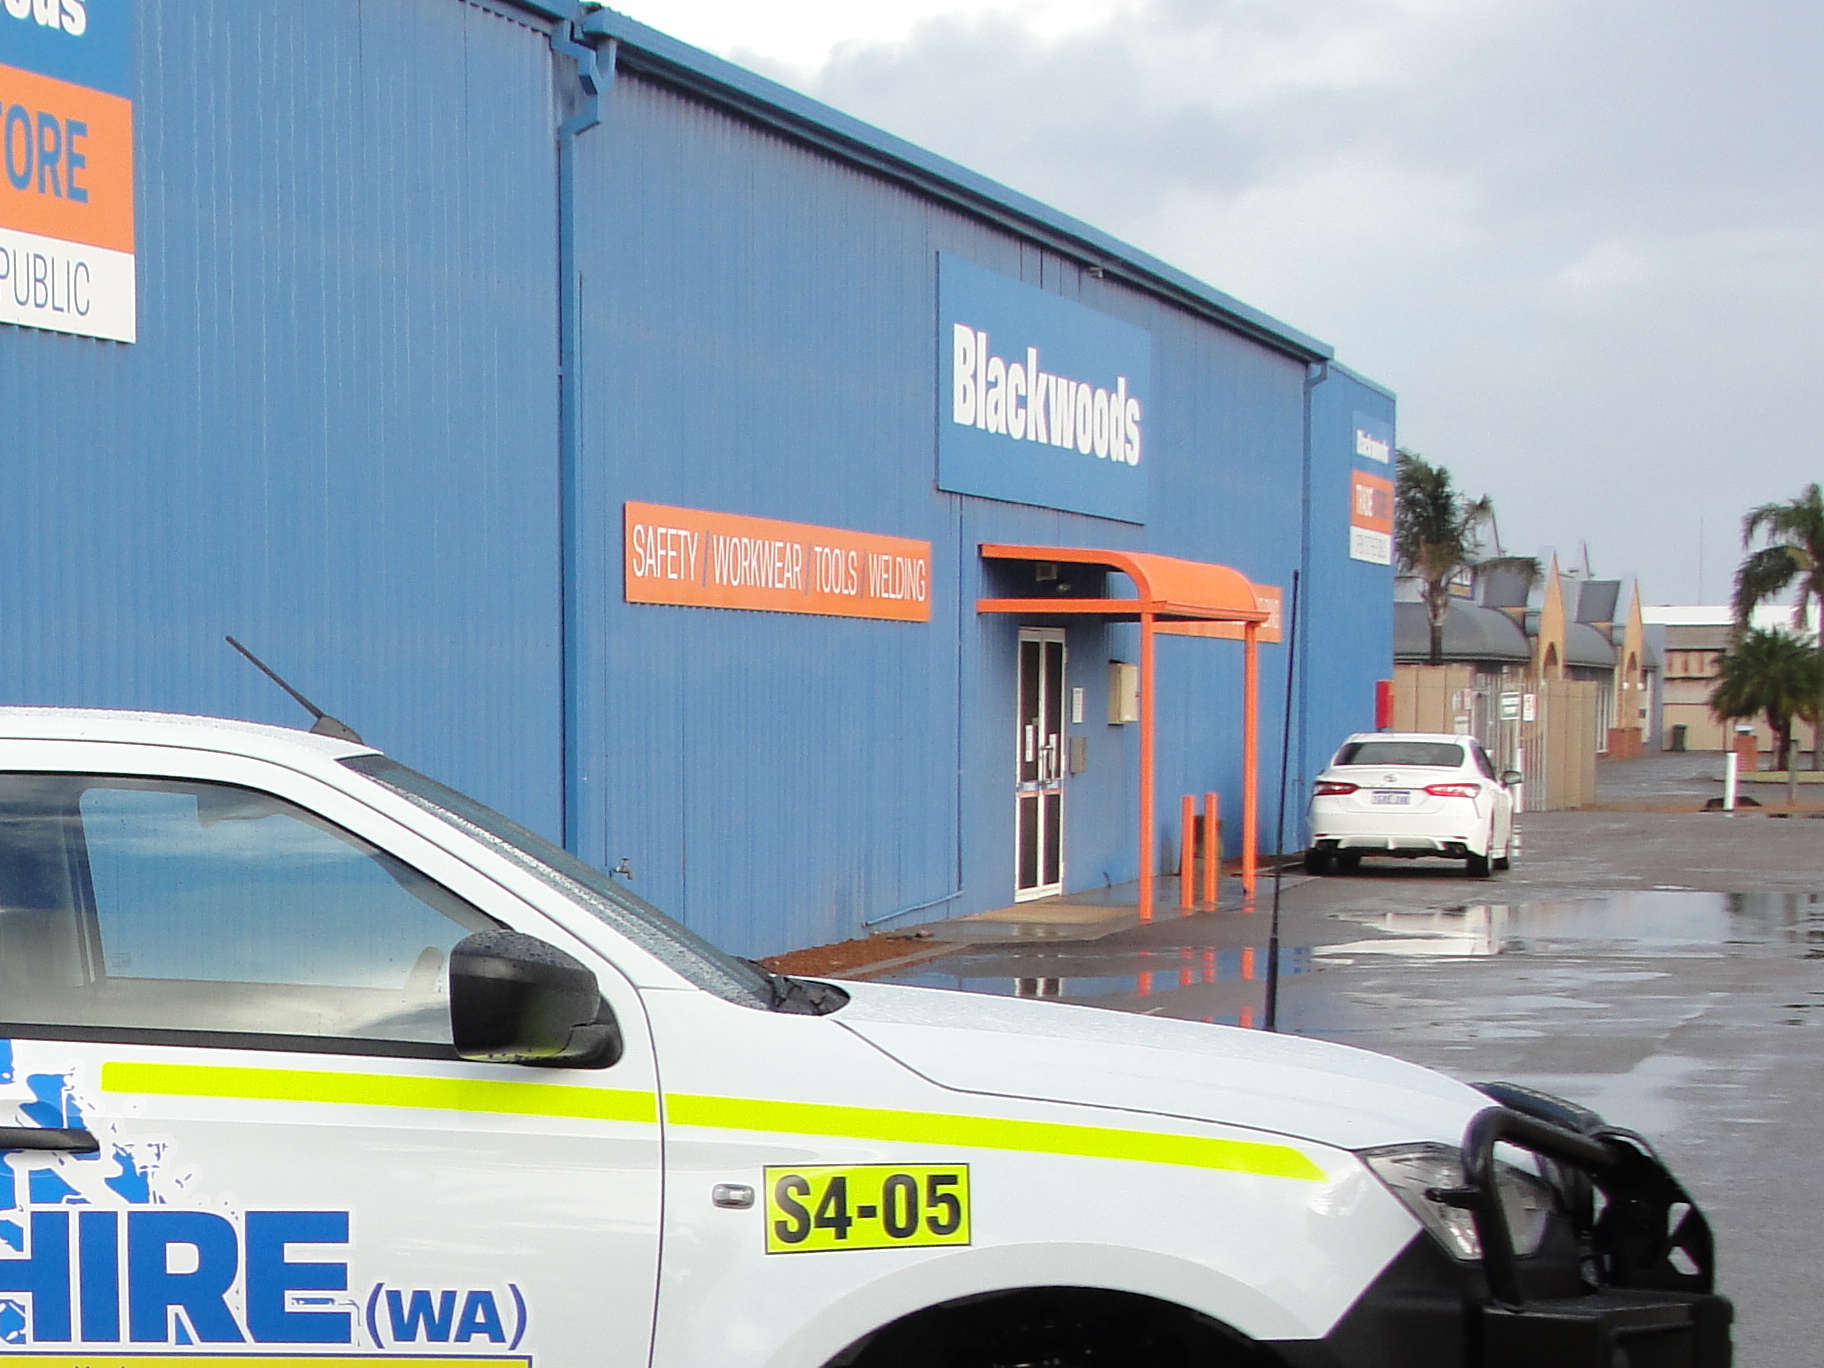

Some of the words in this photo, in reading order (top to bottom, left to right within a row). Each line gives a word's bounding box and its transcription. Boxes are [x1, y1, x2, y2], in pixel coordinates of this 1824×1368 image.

[953, 322, 1142, 467] Blackwoods
[632, 523, 699, 582] SAFETY
[712, 534, 803, 590] WORKWEAR
[814, 546, 858, 596] TOOLS
[869, 552, 927, 602] WELDING
[774, 1173, 962, 1245] S4-05
[366, 1282, 527, 1349] (WA)
